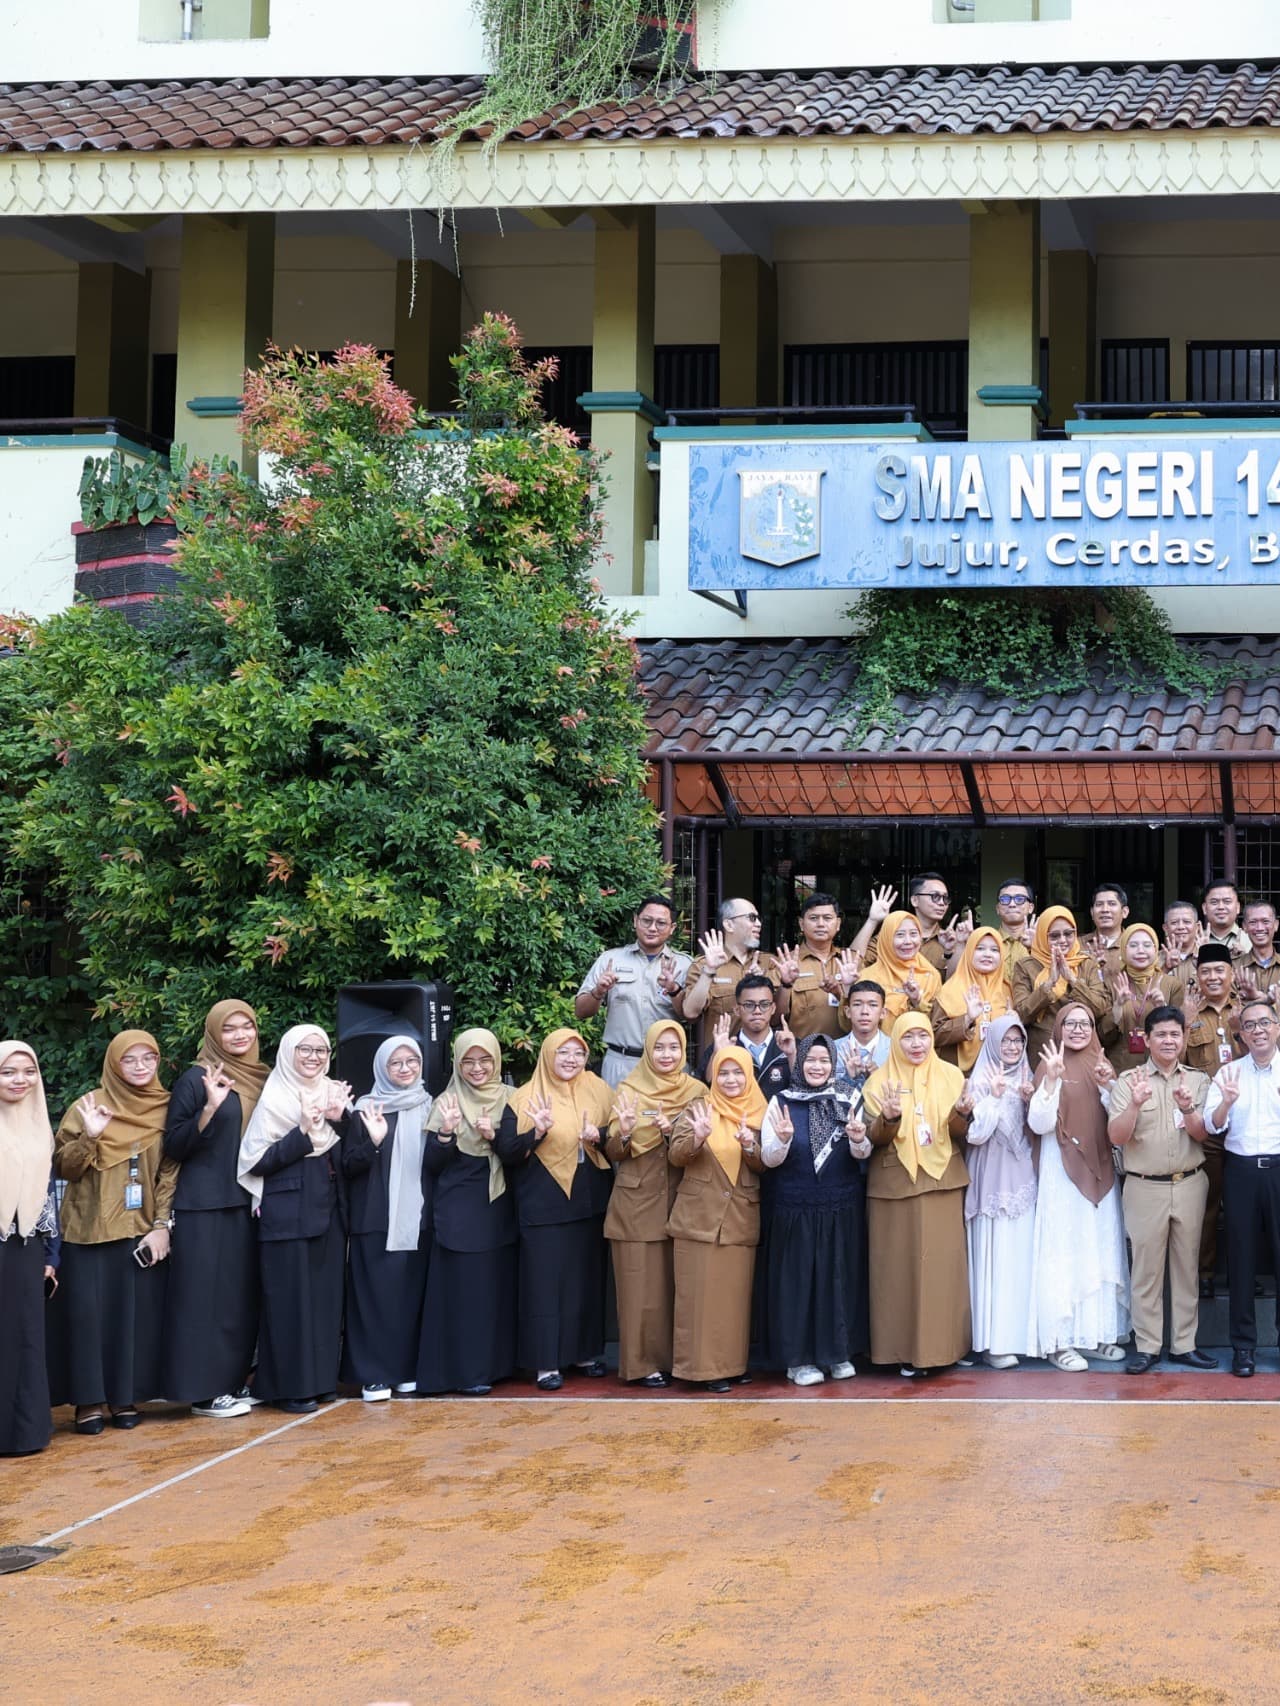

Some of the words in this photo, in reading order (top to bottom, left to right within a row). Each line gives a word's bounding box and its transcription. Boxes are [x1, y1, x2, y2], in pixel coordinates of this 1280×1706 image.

[874, 454, 993, 522] SMA
[1009, 450, 1214, 519] NEGERI
[896, 532, 1029, 575] Jujur,
[1045, 529, 1231, 571] Cerdas,
